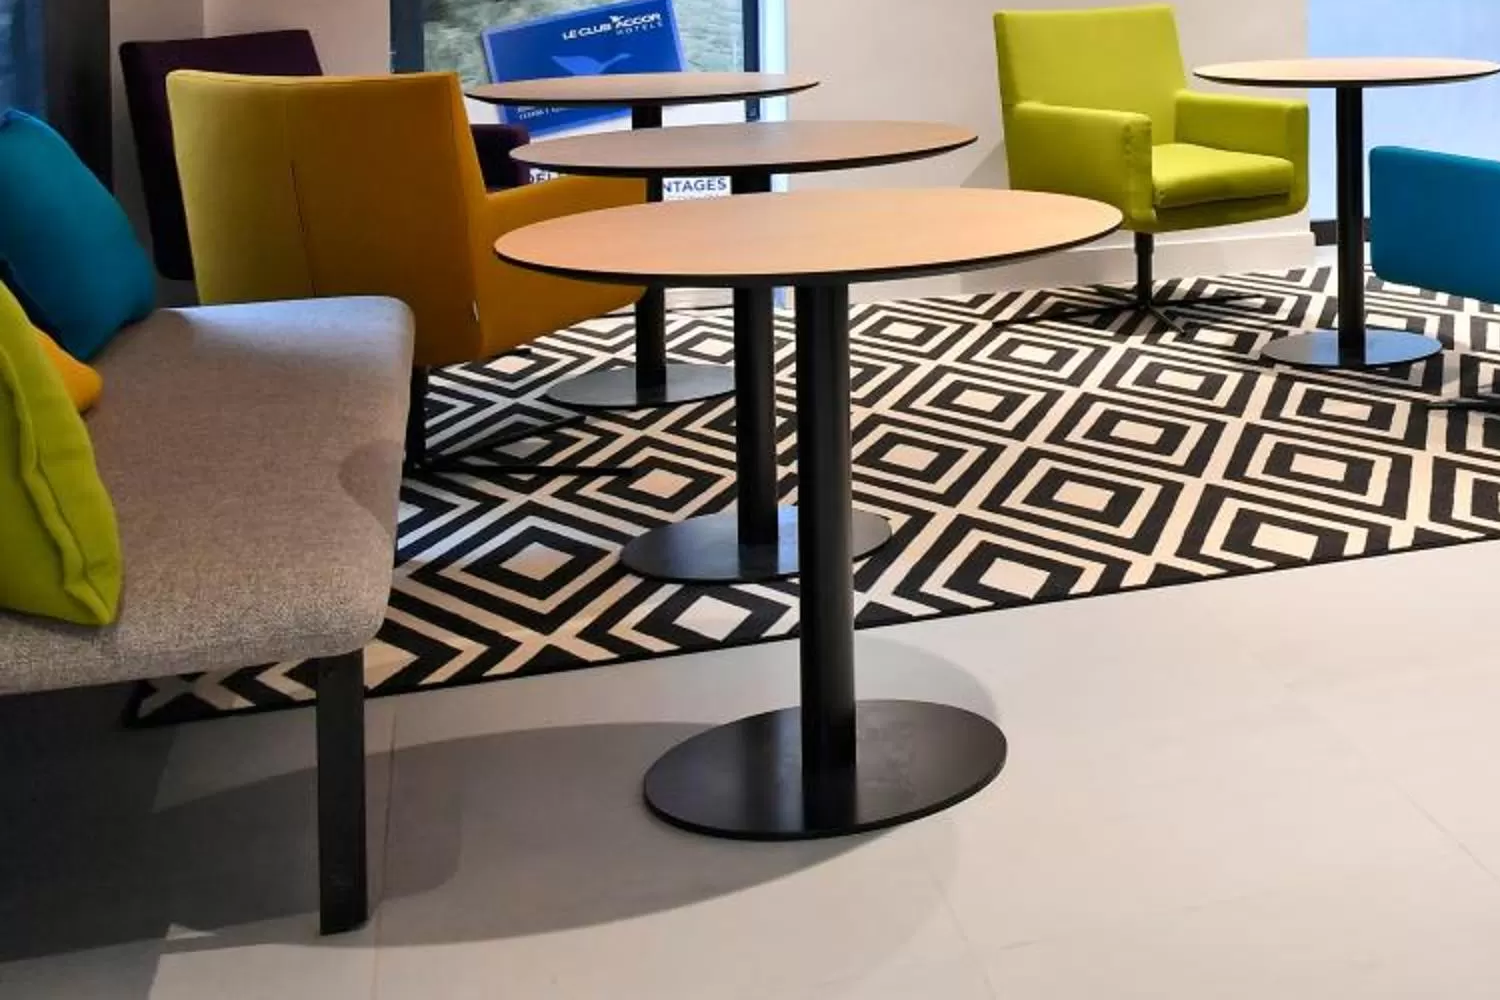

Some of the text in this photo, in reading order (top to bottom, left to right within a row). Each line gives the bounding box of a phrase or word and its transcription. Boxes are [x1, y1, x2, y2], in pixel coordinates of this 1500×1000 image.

[562, 12, 661, 40] LE CLUB ACCOR
[664, 177, 727, 193] NTAGES
